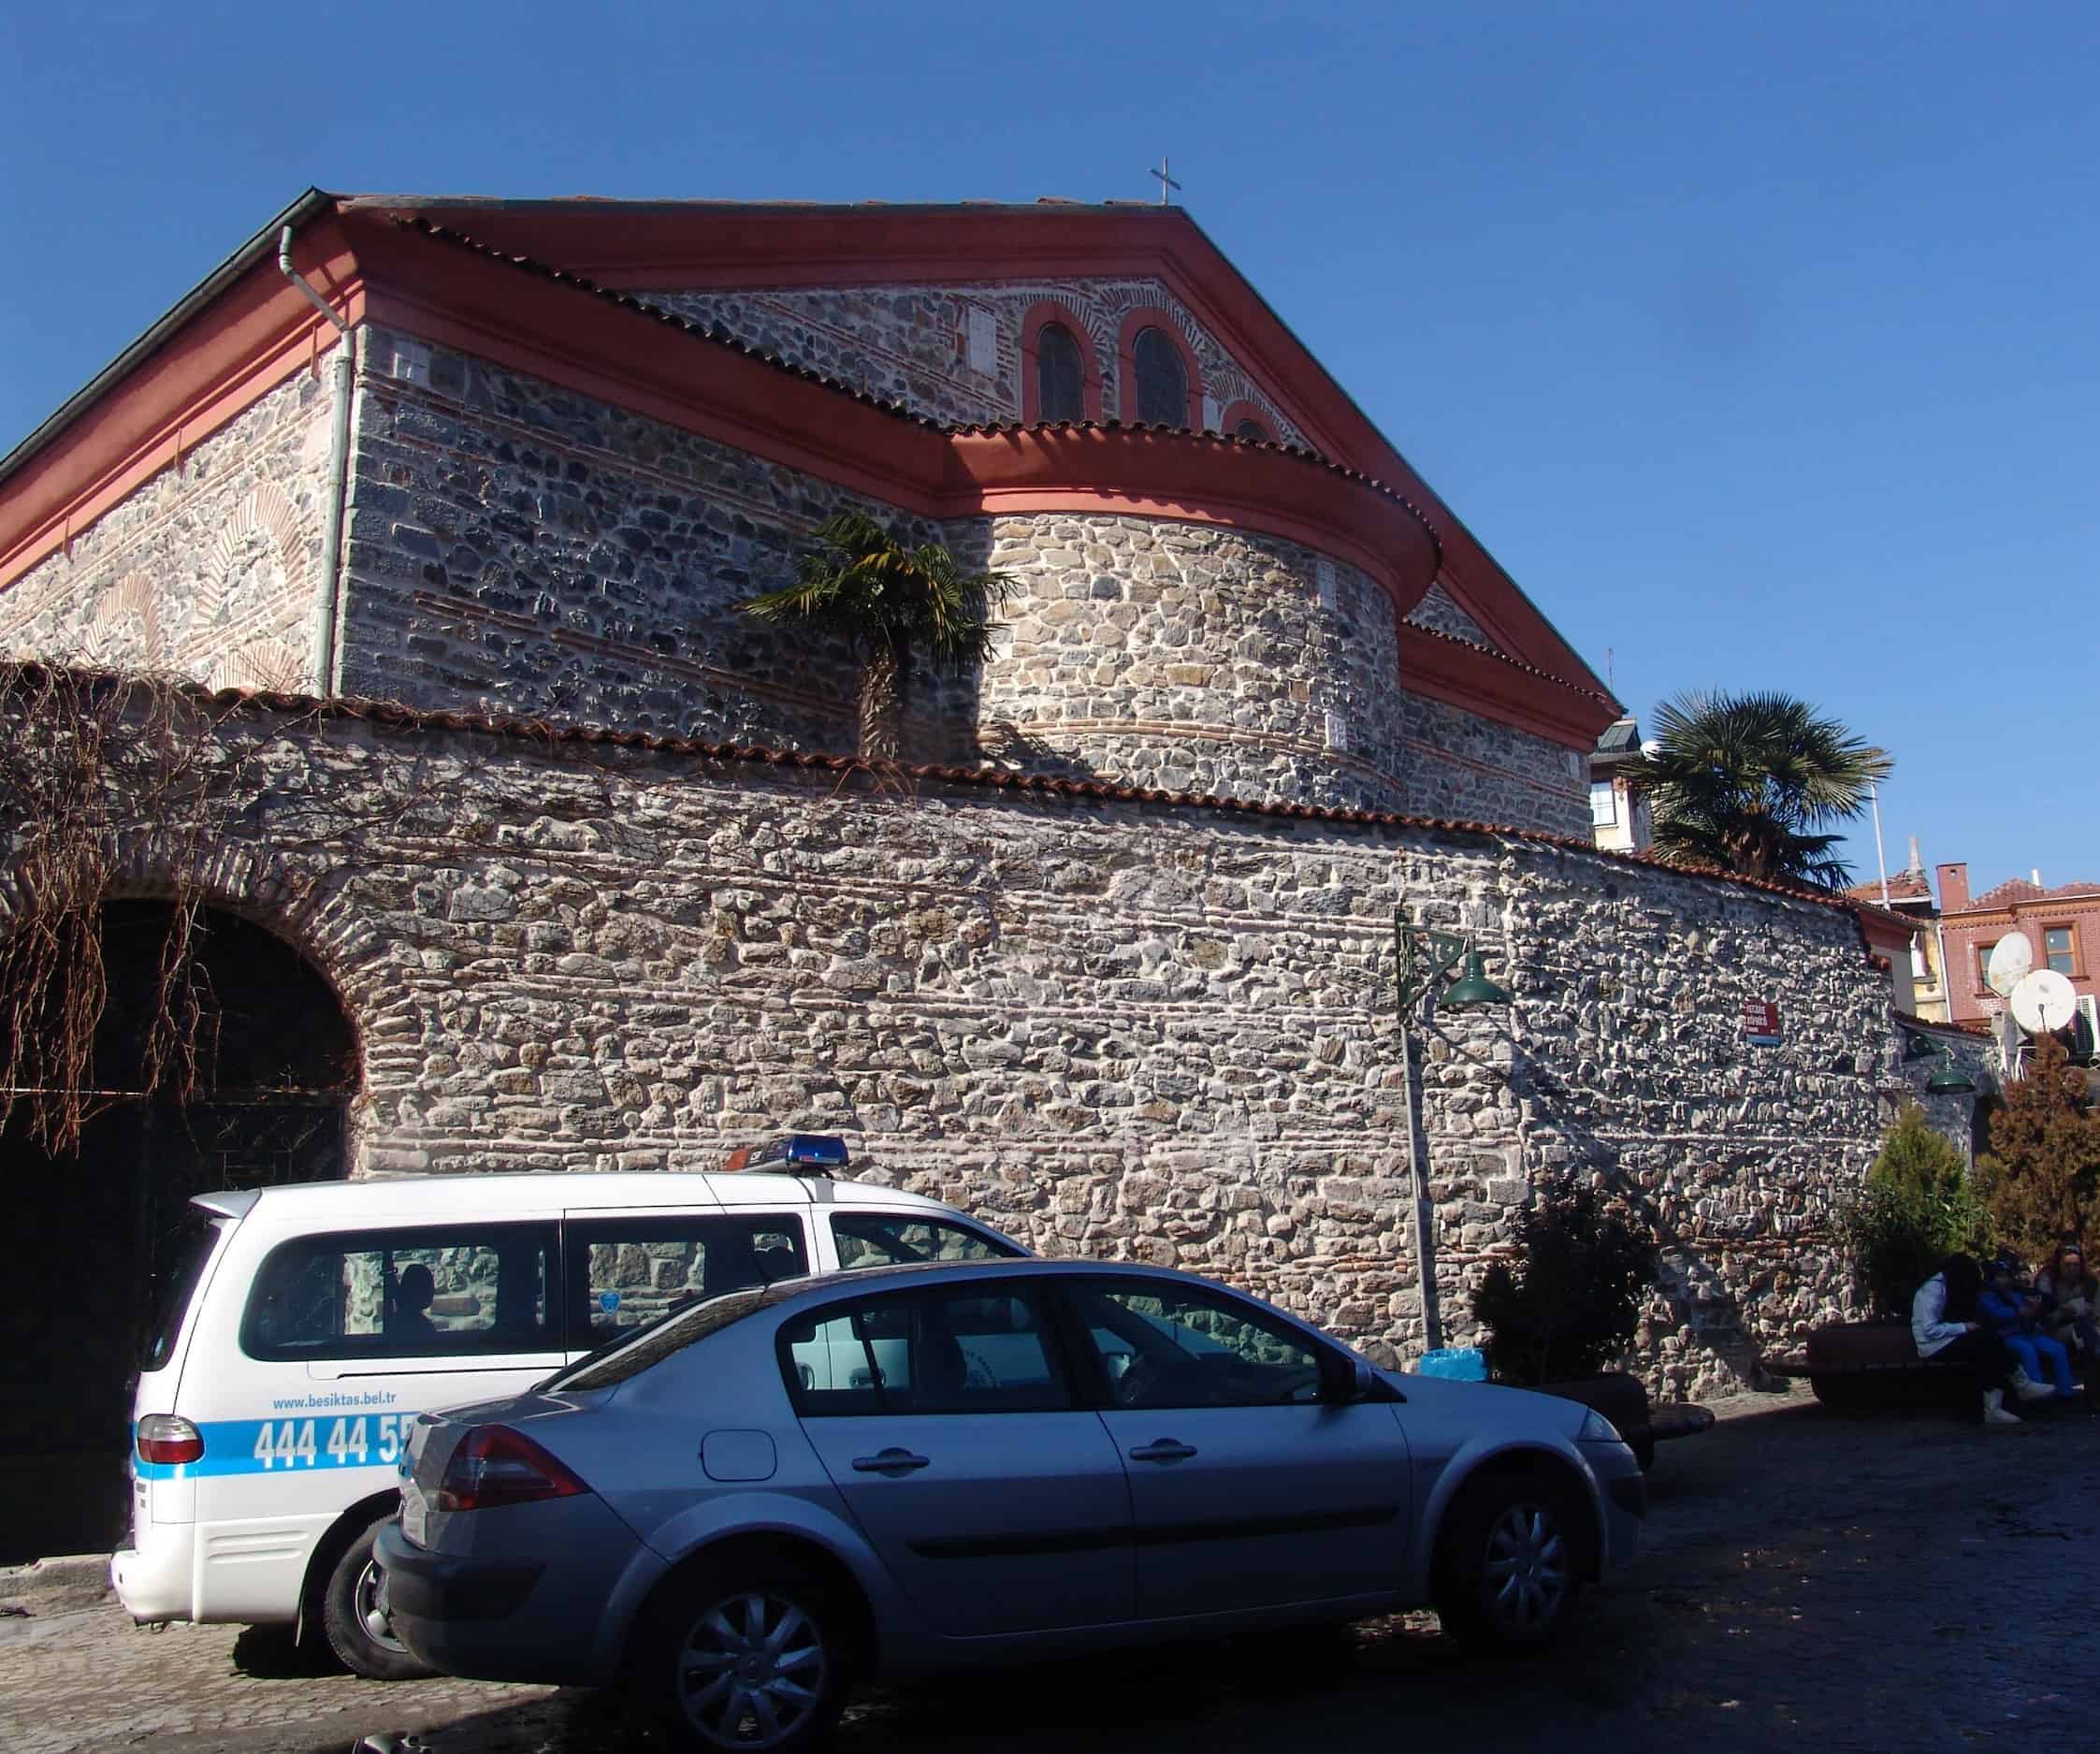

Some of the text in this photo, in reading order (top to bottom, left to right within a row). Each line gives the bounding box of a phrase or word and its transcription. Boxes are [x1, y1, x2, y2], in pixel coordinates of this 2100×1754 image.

[273, 1391, 397, 1410] www.besiktas.bel.tr
[253, 1419, 317, 1469] 444
[326, 1416, 369, 1465] 44
